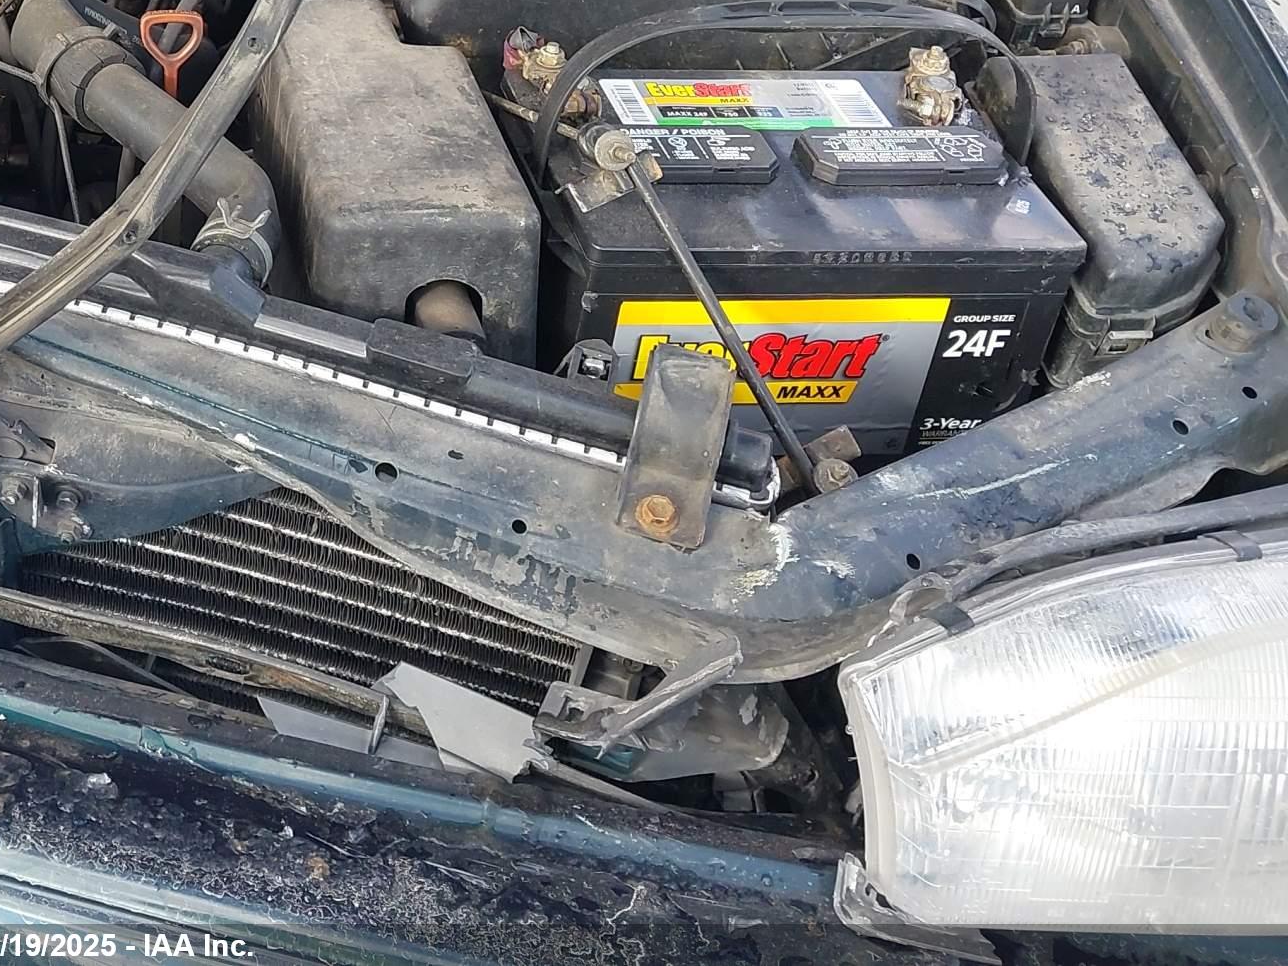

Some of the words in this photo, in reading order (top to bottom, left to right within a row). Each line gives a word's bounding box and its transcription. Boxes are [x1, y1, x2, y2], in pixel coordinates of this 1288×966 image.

[1070, 4, 1081, 14] A
[645, 81, 751, 97] EverStart
[953, 314, 992, 323] GROUP
[993, 314, 1016, 323] SIZE
[942, 329, 1011, 358] 24F
[777, 386, 846, 399] MAXX
[919, 417, 982, 430] 3-Year
